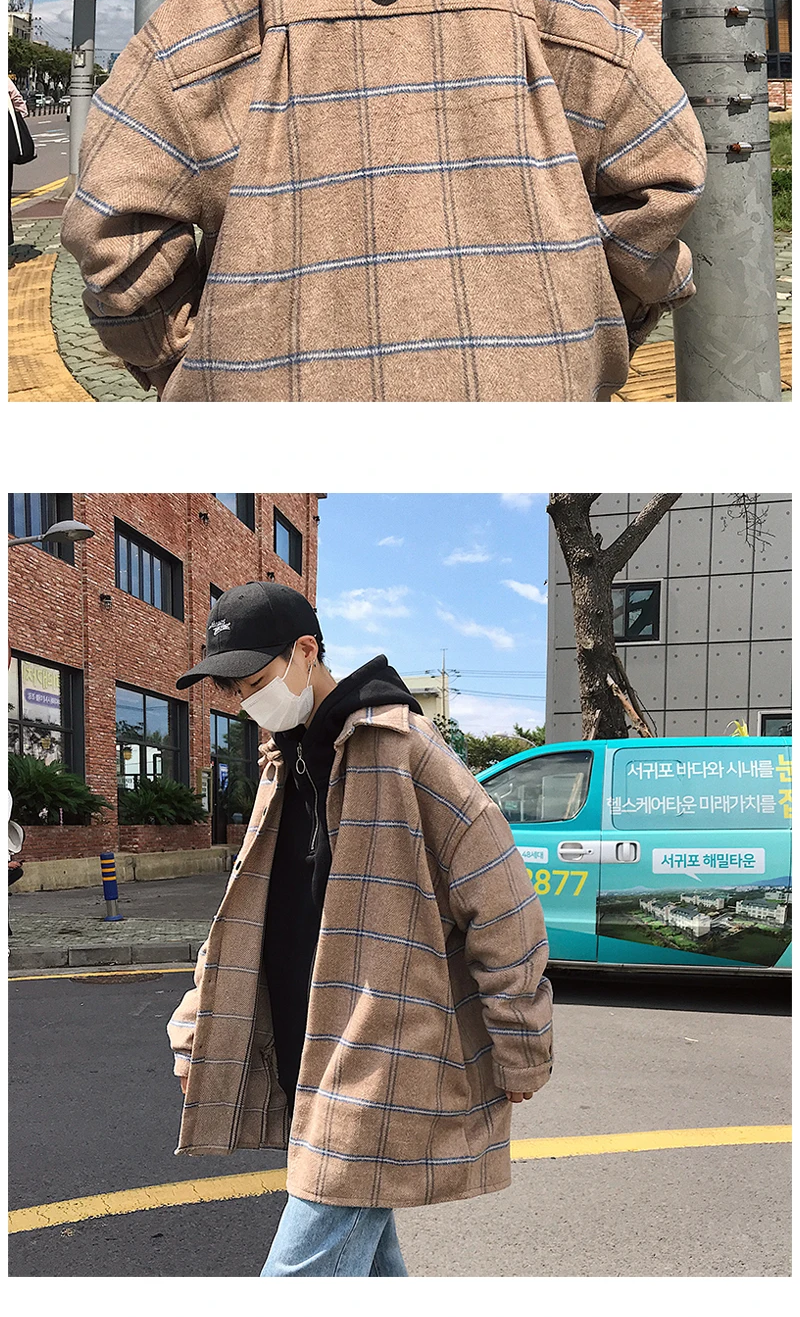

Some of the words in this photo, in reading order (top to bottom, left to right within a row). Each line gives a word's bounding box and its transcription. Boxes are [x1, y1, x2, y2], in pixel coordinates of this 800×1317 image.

[627, 762, 675, 780] 서귀포
[676, 761, 725, 779] 바다와
[726, 760, 774, 779] 시내를
[606, 795, 697, 815] 헬스케어타운
[699, 795, 777, 814] 미래가치를
[661, 853, 700, 868] 서귀포
[703, 853, 756, 868] 해밀타운
